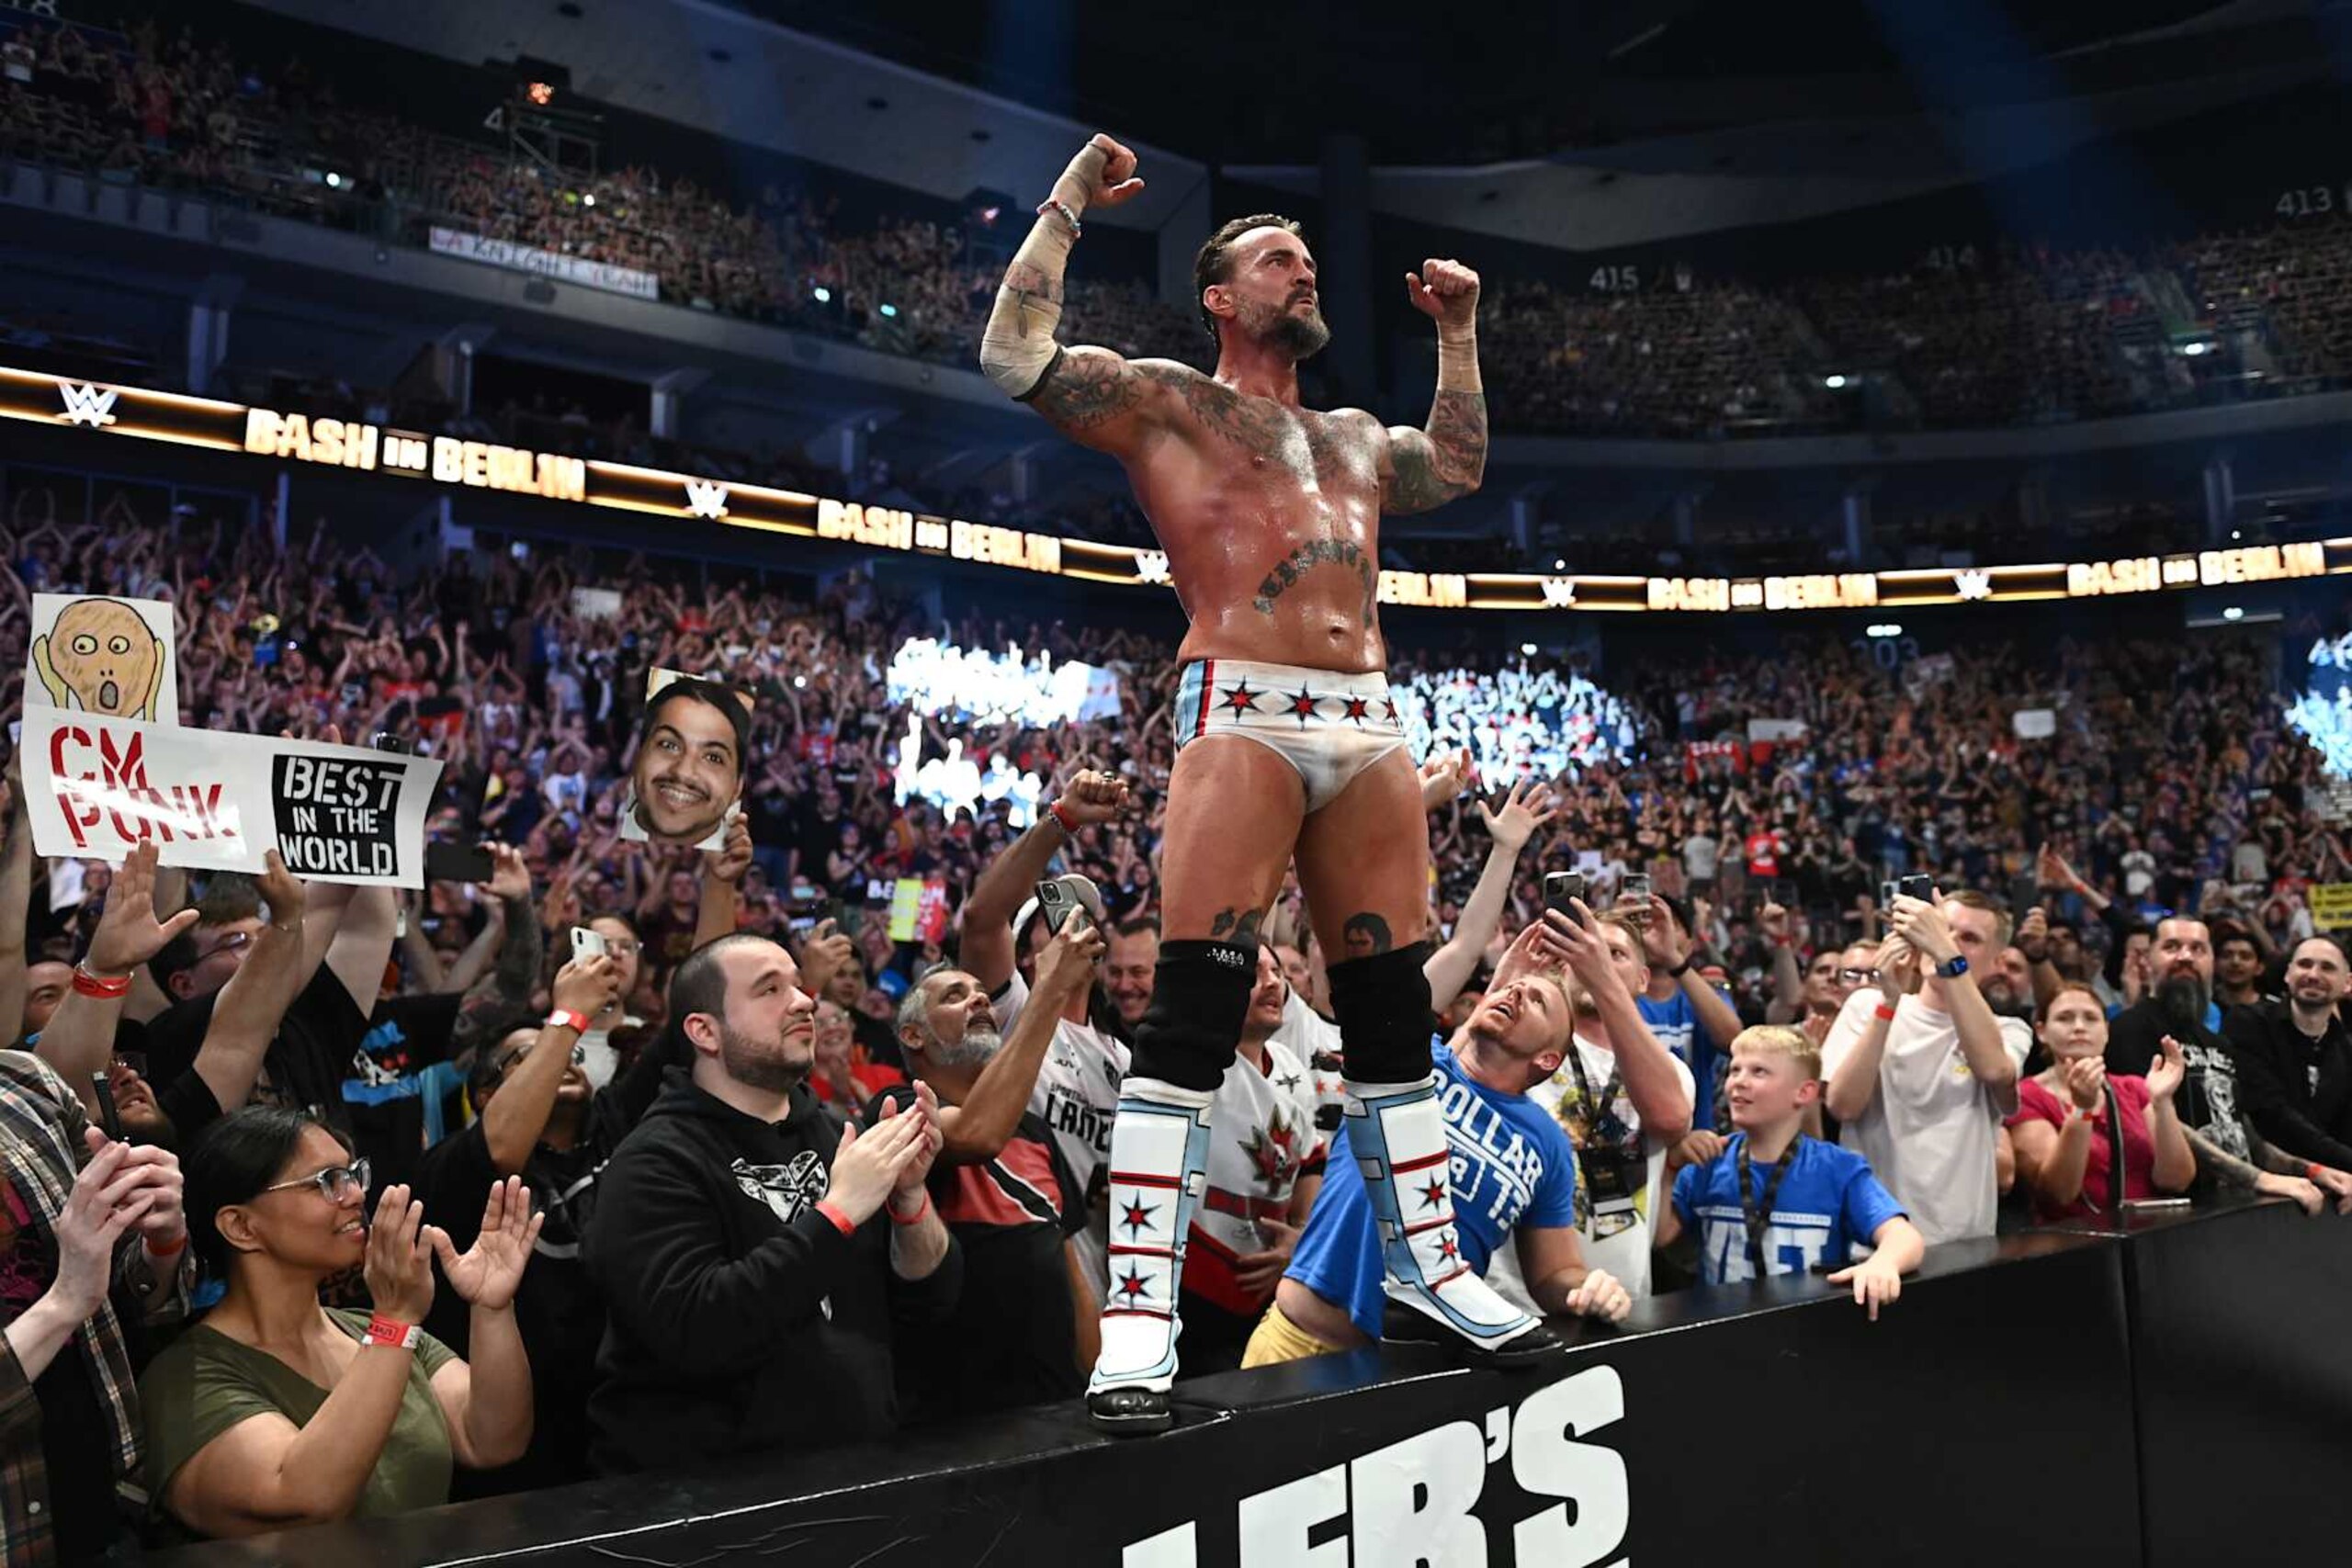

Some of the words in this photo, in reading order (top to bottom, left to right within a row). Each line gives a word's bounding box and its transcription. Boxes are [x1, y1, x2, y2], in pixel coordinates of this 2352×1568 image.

[2274, 186, 2333, 217] 413
[1589, 265, 1640, 291] 415
[245, 408, 378, 470] BASH
[383, 436, 426, 470] IN
[433, 436, 585, 502] BERLIN
[818, 499, 912, 549] BASH
[951, 521, 1060, 573] BERLIN
[1376, 570, 1465, 606] ERLIN
[1647, 578, 1730, 611] BASH
[1764, 573, 1877, 610] BERLIN
[2067, 558, 2162, 596] BASH
[2199, 541, 2325, 586] BERLIN
[50, 725, 148, 792] CM
[283, 756, 407, 811] BEST
[56, 784, 236, 847] PUNK
[292, 807, 317, 833] IN
[331, 807, 379, 834] THE
[278, 831, 393, 876] WORLD
